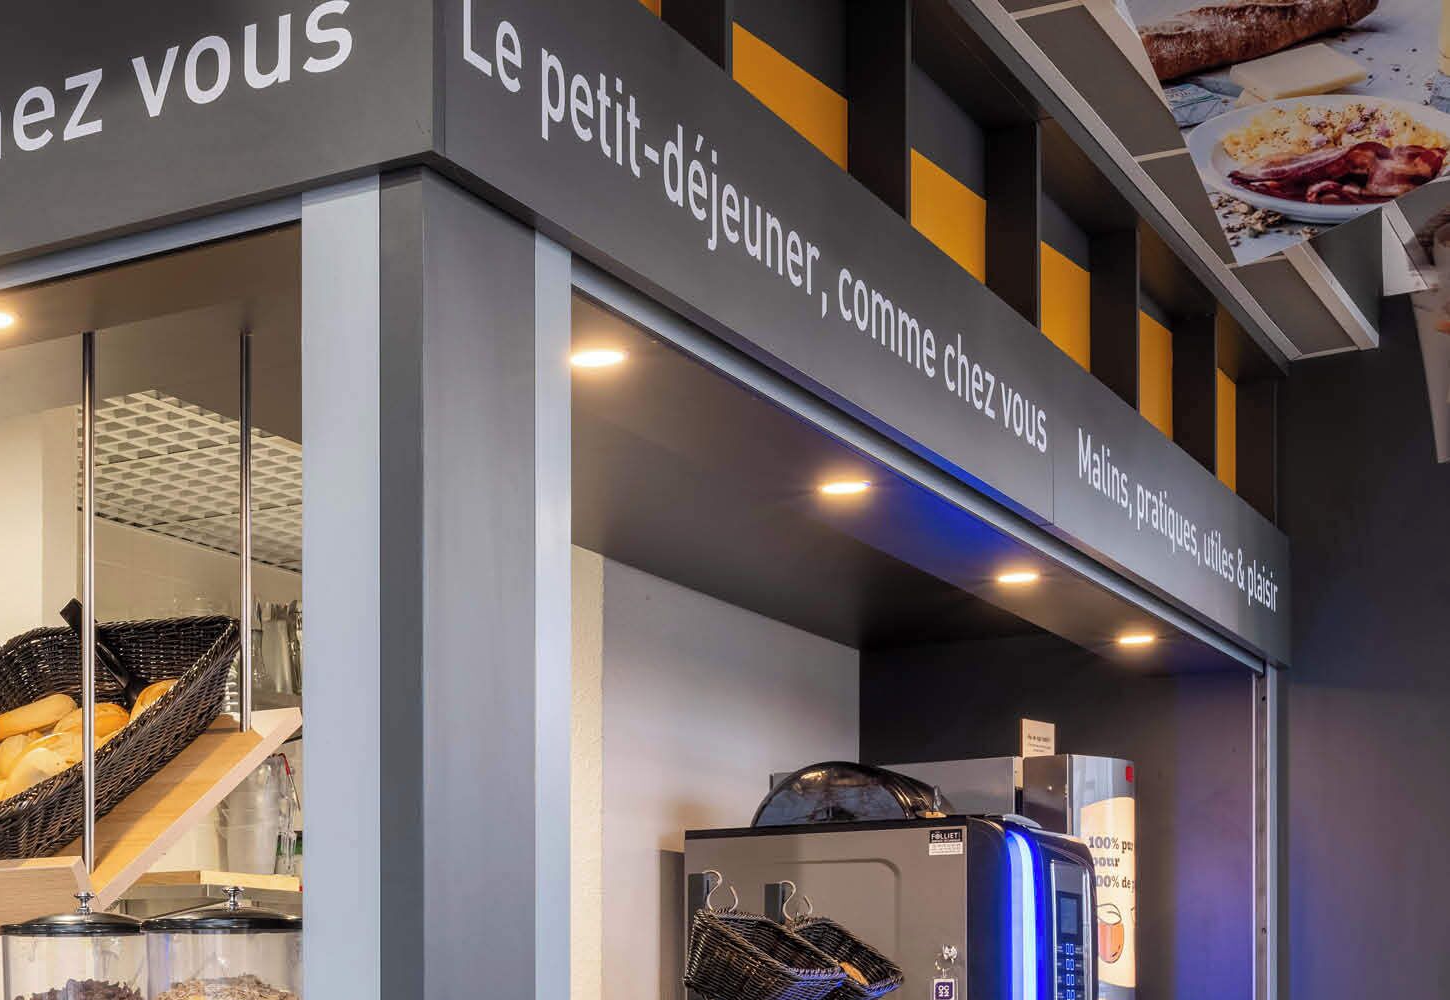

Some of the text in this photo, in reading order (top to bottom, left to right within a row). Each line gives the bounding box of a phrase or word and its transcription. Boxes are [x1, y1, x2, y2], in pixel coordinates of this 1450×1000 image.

[131, 0, 353, 118] vous
[462, 0, 1048, 454] Le petit-déjeuner, comme chez vous
[1077, 427, 1279, 614] Malins, pratiques, utiles & plaisir
[1089, 836, 1120, 849] 100%
[1096, 875, 1120, 888] 00%
